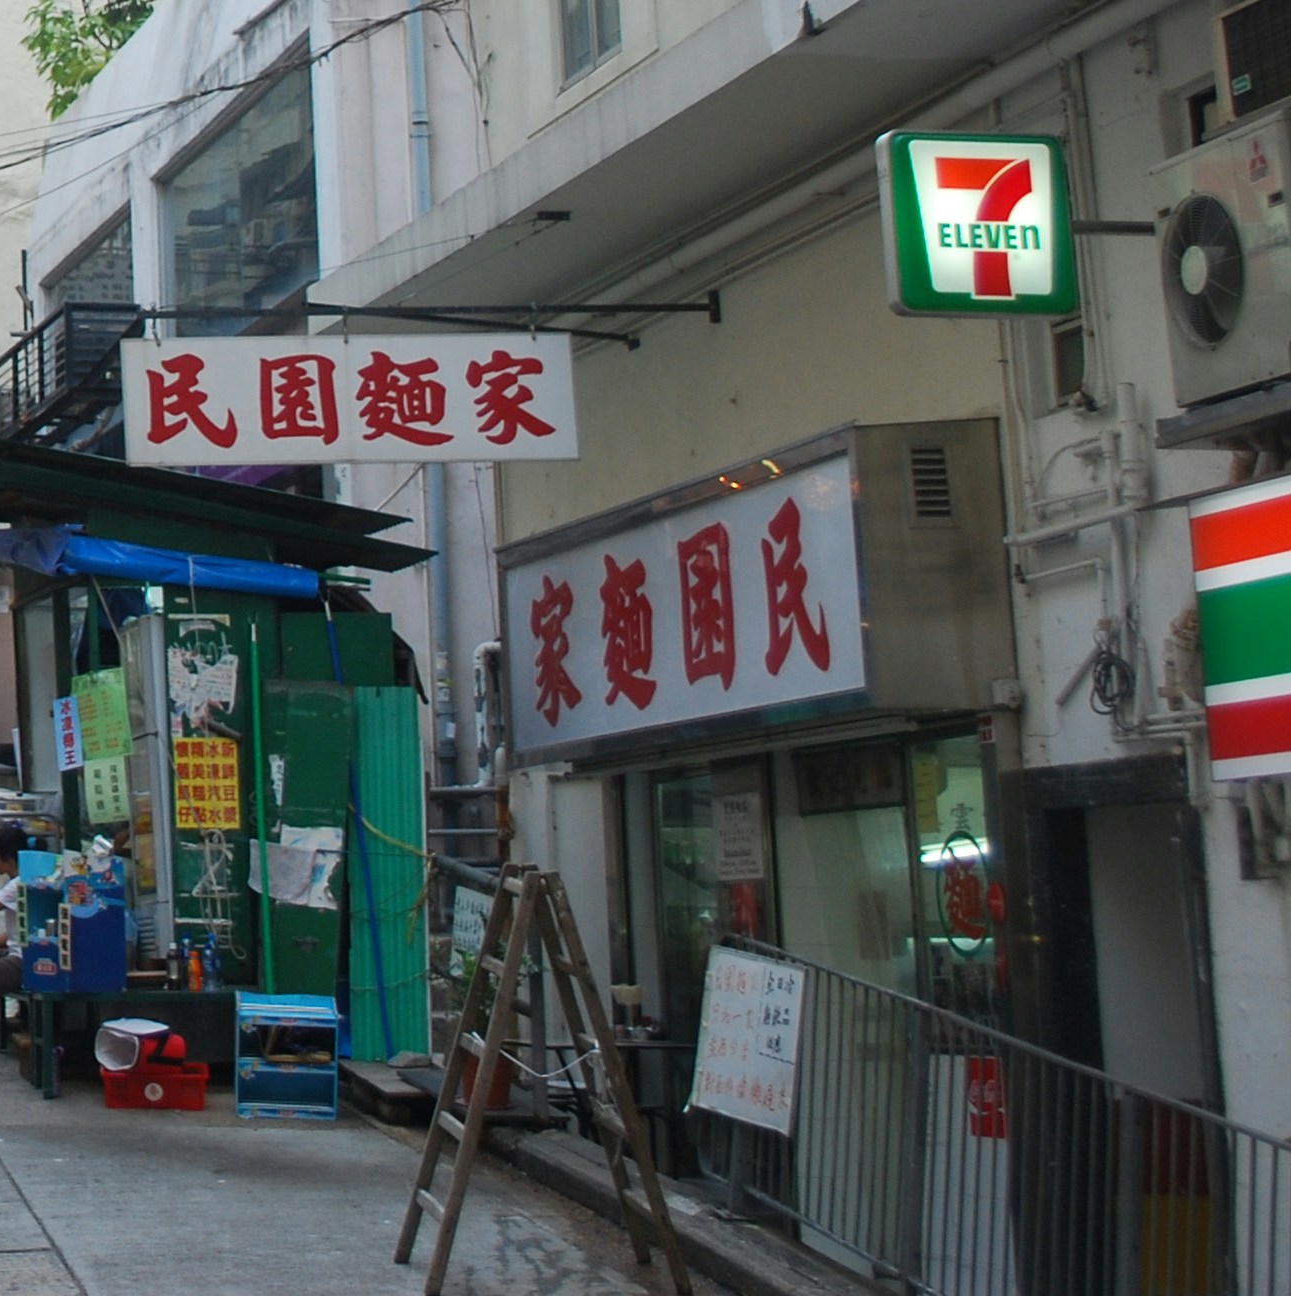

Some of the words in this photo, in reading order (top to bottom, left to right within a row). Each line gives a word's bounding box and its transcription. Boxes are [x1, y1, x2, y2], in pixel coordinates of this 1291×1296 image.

[935, 156, 1032, 297] 7
[145, 350, 557, 449] 民園麵家
